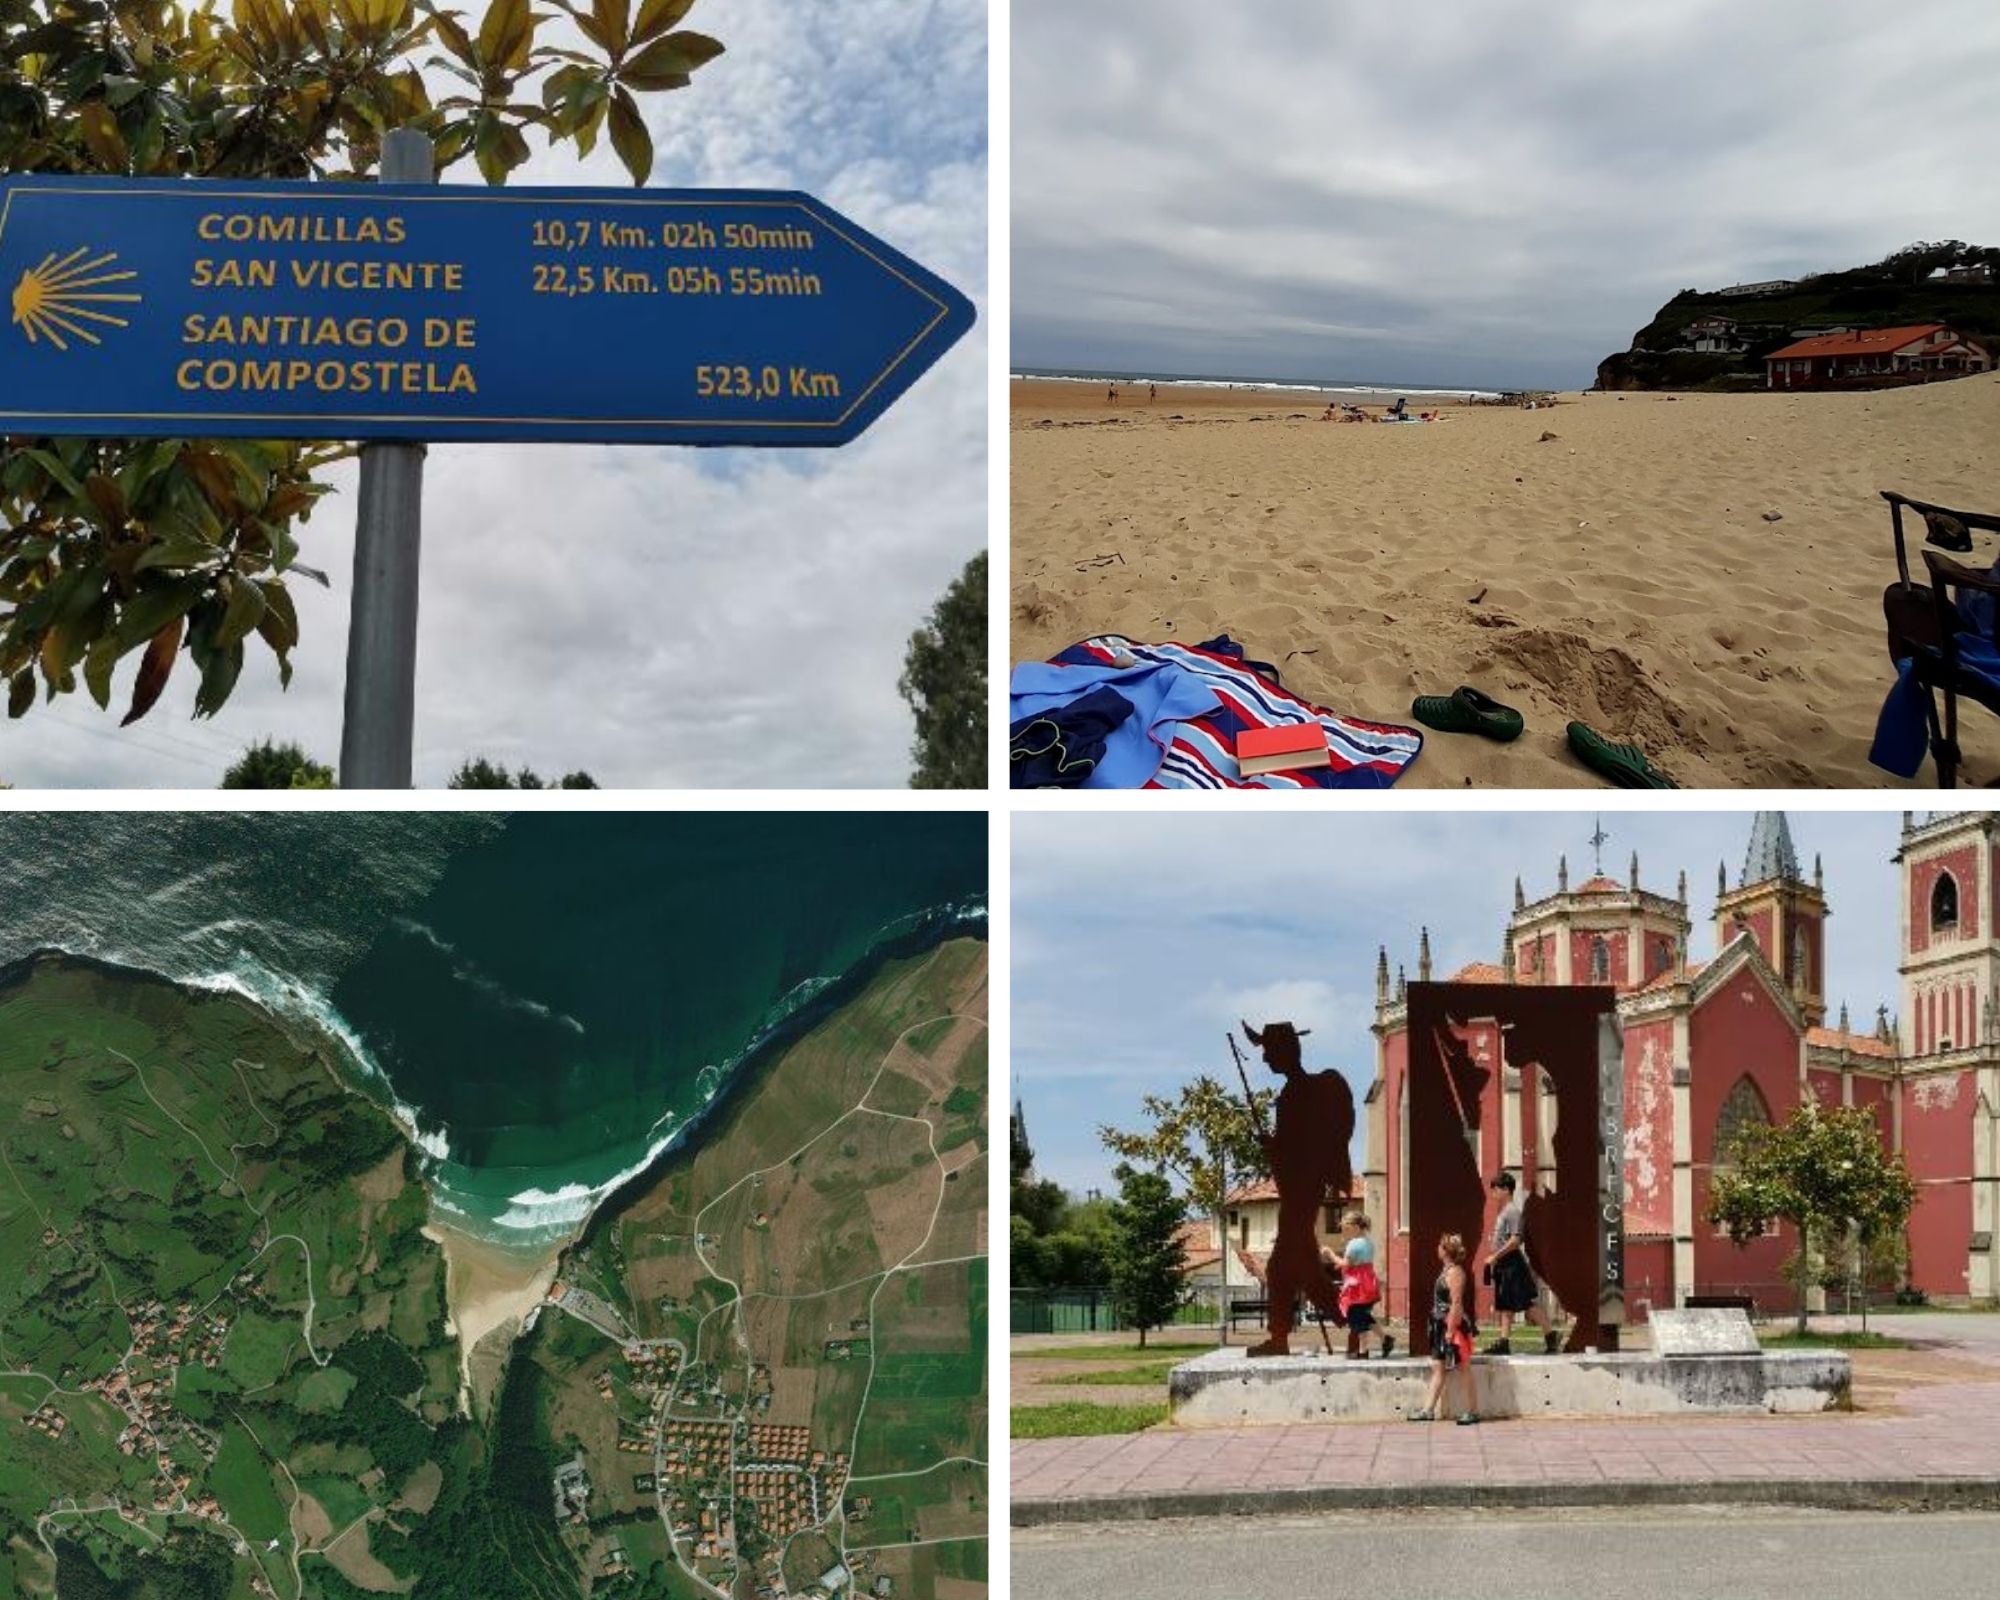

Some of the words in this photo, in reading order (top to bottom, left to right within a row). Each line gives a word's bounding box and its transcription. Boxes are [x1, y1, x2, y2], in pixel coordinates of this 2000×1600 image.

[198, 212, 406, 246] COMILLAS
[533, 220, 592, 254] 10,7
[599, 222, 657, 248] Km.
[661, 222, 718, 250] 02h
[722, 223, 814, 252] 50min
[191, 257, 278, 290] SAN
[290, 259, 463, 292] VICENTE
[533, 263, 597, 298] 22,5
[601, 265, 659, 293] Km.
[666, 266, 723, 295] 05h
[728, 267, 823, 297] 55min
[184, 312, 410, 349] SANTIAGO
[422, 316, 476, 350] DE
[175, 357, 479, 395] COMPOSTELA
[695, 365, 782, 401] 523,0
[788, 367, 842, 399] Km
